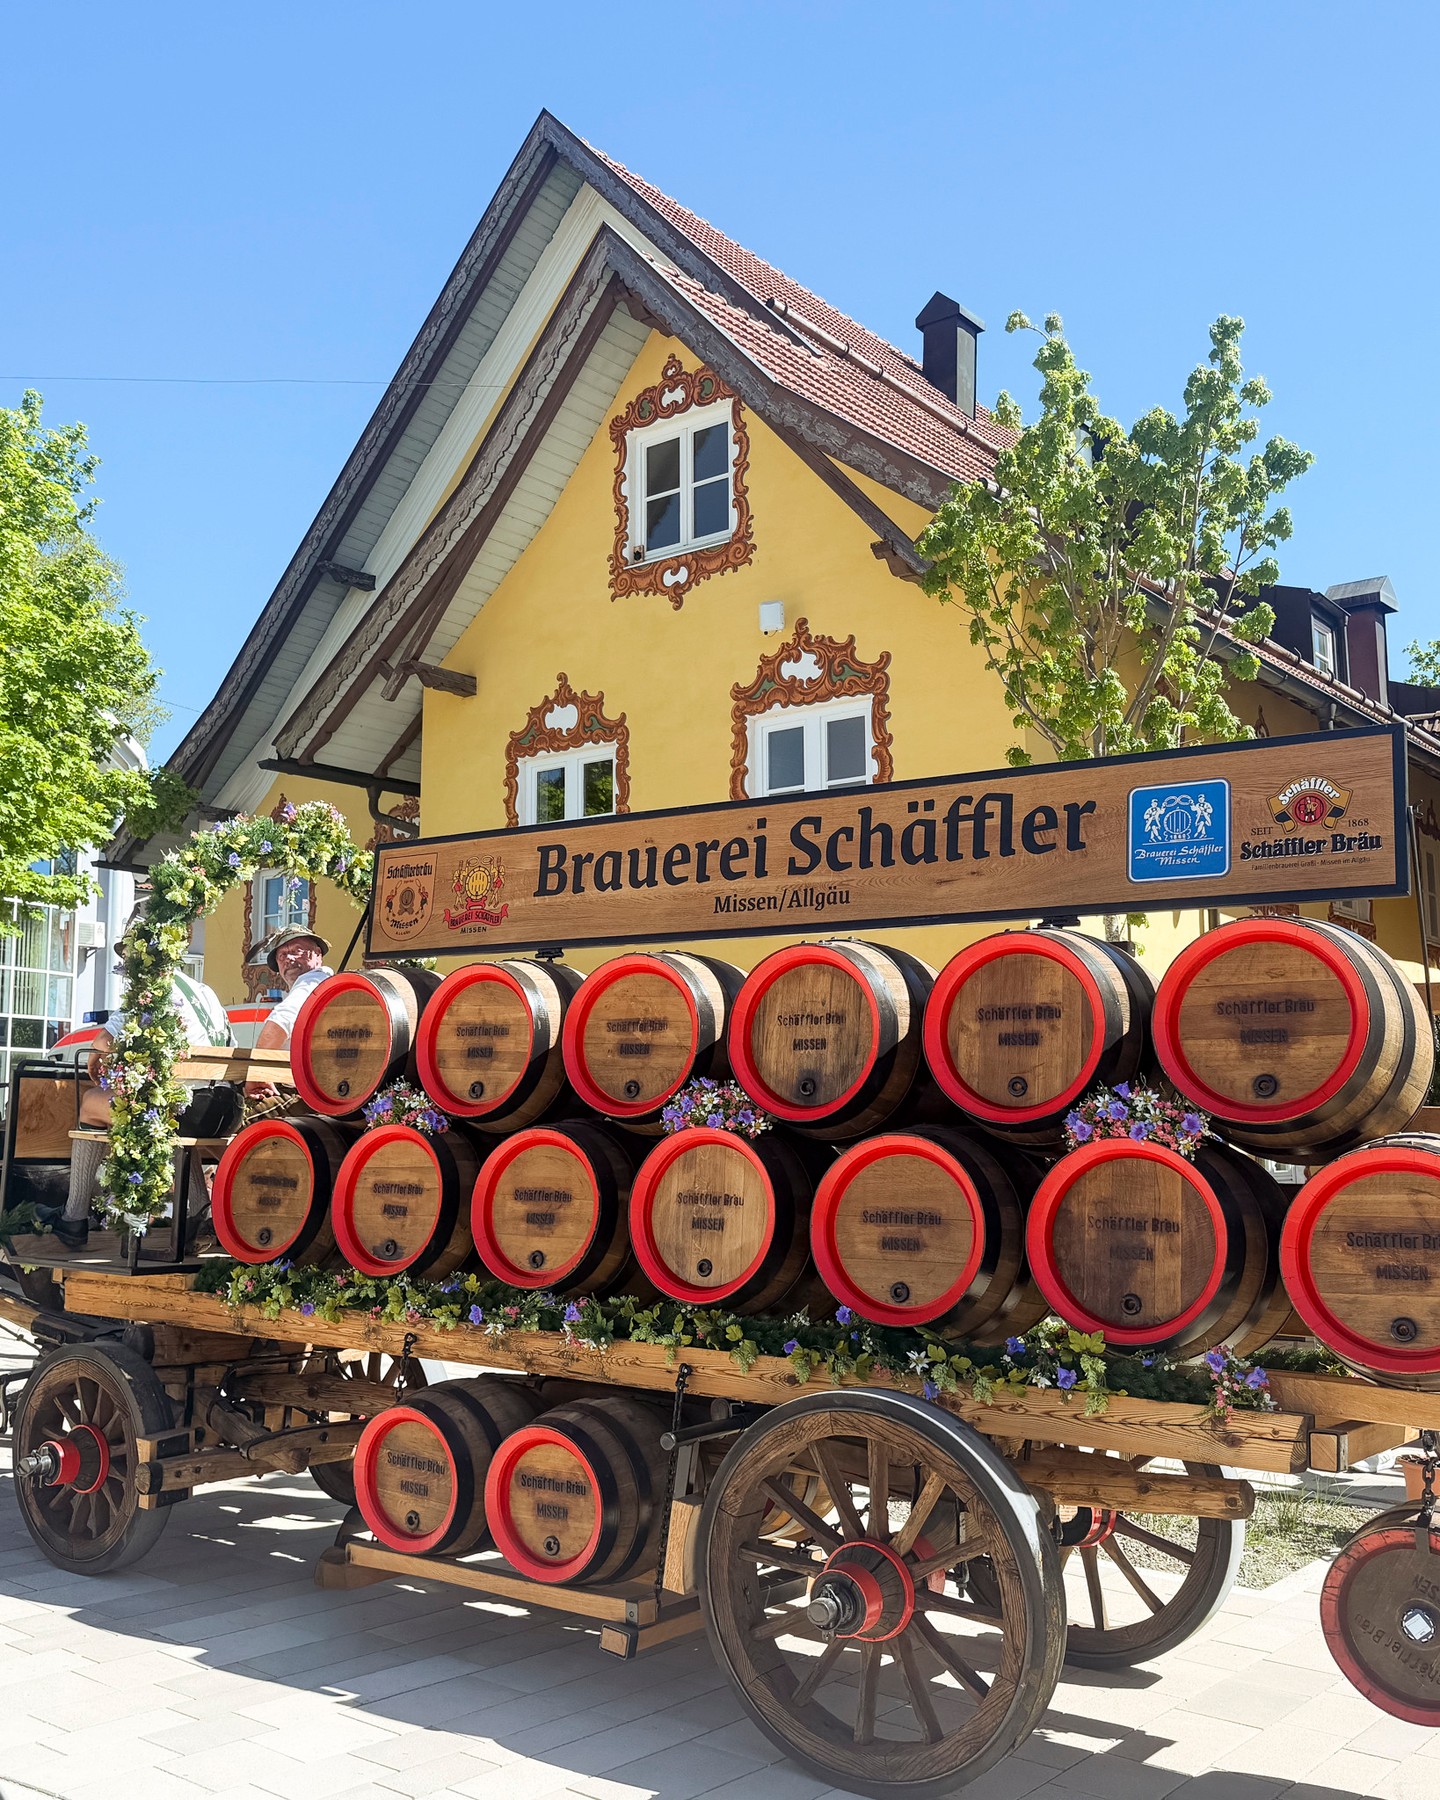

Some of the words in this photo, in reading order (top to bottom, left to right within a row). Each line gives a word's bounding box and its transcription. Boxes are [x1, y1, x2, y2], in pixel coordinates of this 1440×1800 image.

[1278, 778, 1340, 806] Schäffler
[1250, 826, 1273, 836] SEIT
[1347, 819, 1369, 828] 1868
[533, 818, 769, 897] Brauerei
[788, 792, 1097, 876] Schäffler
[1134, 848, 1177, 860] Brauerei
[1178, 844, 1224, 858] Schäffler
[1240, 836, 1329, 862] Schäffler
[1331, 832, 1383, 854] Bräu
[1155, 857, 1200, 866] Missen
[713, 886, 851, 914] Missen/Allgäu
[389, 917, 419, 930] Missen
[460, 926, 487, 934] MISSEN
[777, 1012, 823, 1026] Schäffler
[977, 1006, 1033, 1020] Schäffler
[793, 1038, 827, 1051] MISSEN
[373, 1182, 406, 1195] Schäffler
[514, 1189, 552, 1202] Schäffler
[677, 1191, 722, 1206] Schäffler
[723, 1192, 744, 1207] Bräu
[691, 1217, 725, 1231] MISSEN
[862, 1209, 914, 1225] Schäffler
[917, 1210, 942, 1226] Bräu
[1087, 1215, 1148, 1232] Schäffler
[1151, 1217, 1180, 1233] Bräu
[881, 1236, 921, 1251] MISSEN
[1346, 1231, 1419, 1249] Schäffler
[1423, 1233, 1440, 1250] Br
[1376, 1264, 1429, 1281] MISSEN
[387, 1451, 426, 1471] Schäffler
[427, 1459, 446, 1475] Bräu
[400, 1480, 429, 1497] MISSEN
[521, 1474, 564, 1493] Schäffler
[566, 1479, 587, 1496] Bräu
[536, 1502, 569, 1521] MISSEN
[1412, 1573, 1440, 1601] SEN
